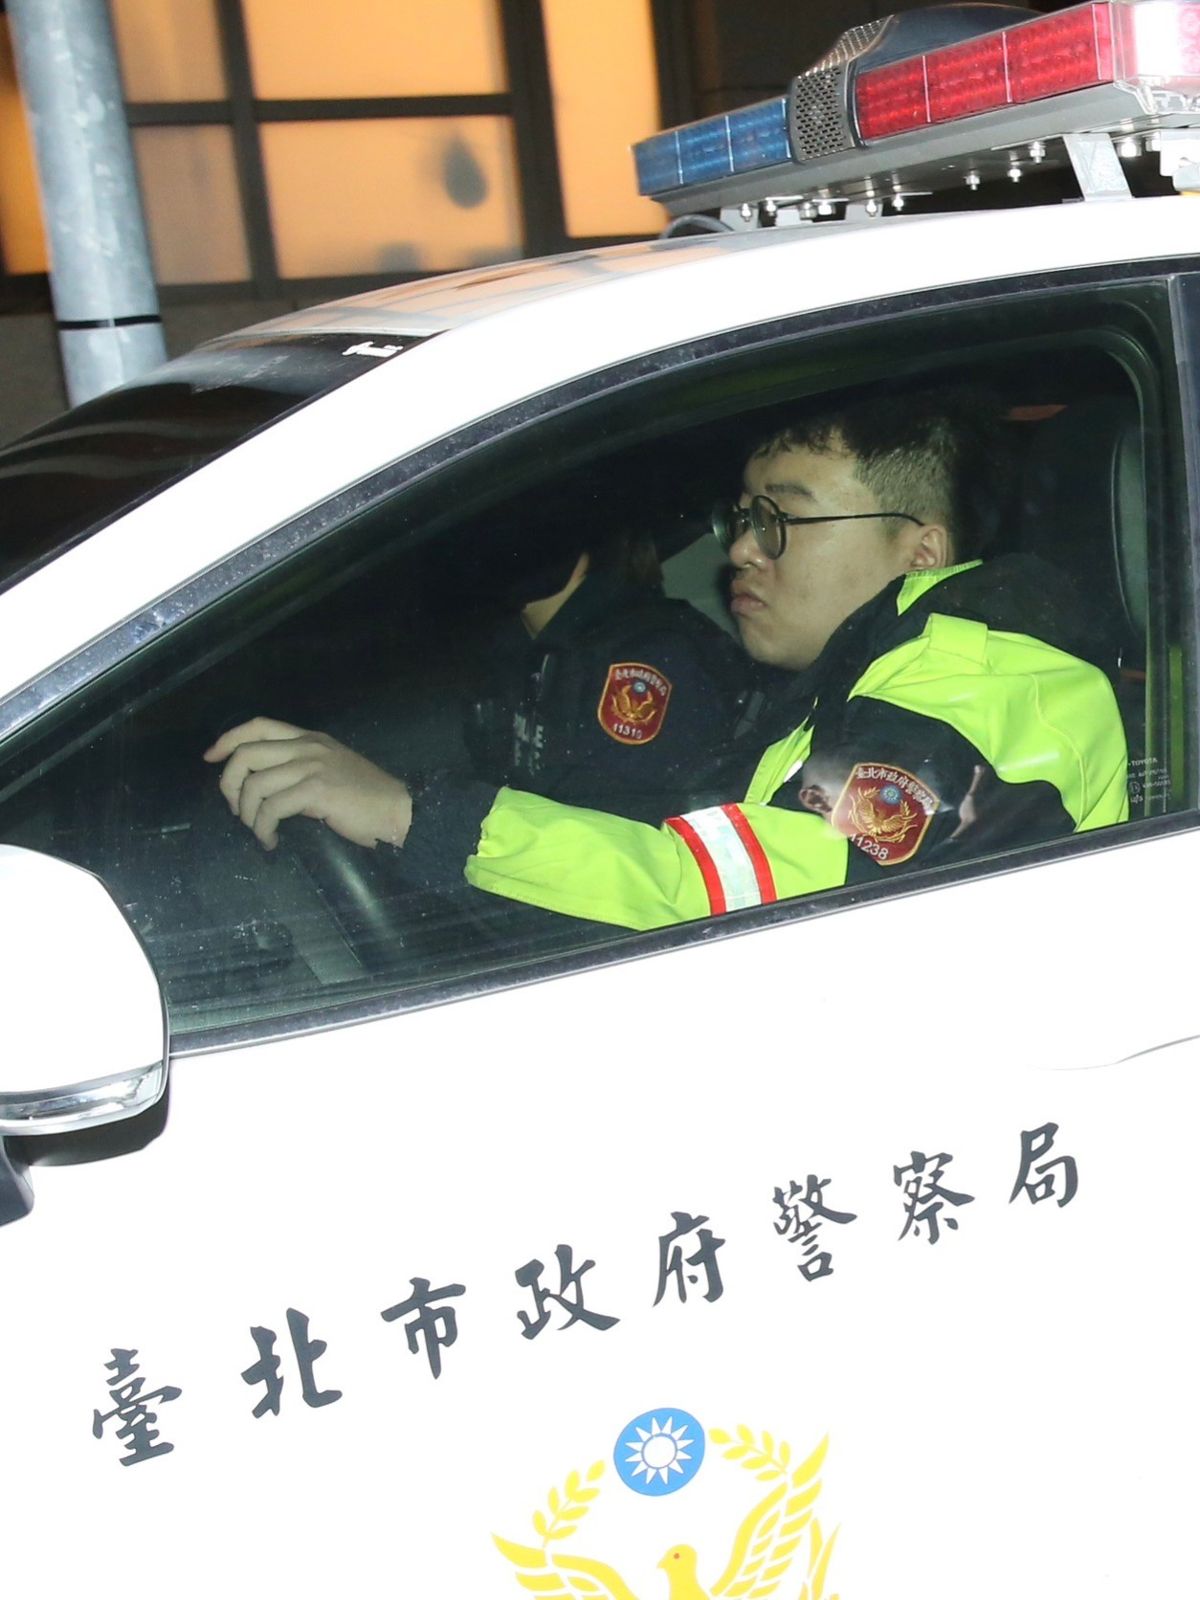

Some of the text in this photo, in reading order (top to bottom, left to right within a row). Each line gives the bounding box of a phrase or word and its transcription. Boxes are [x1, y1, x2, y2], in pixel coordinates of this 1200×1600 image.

[92, 1122, 1079, 1467] 臺北市政府警察局
